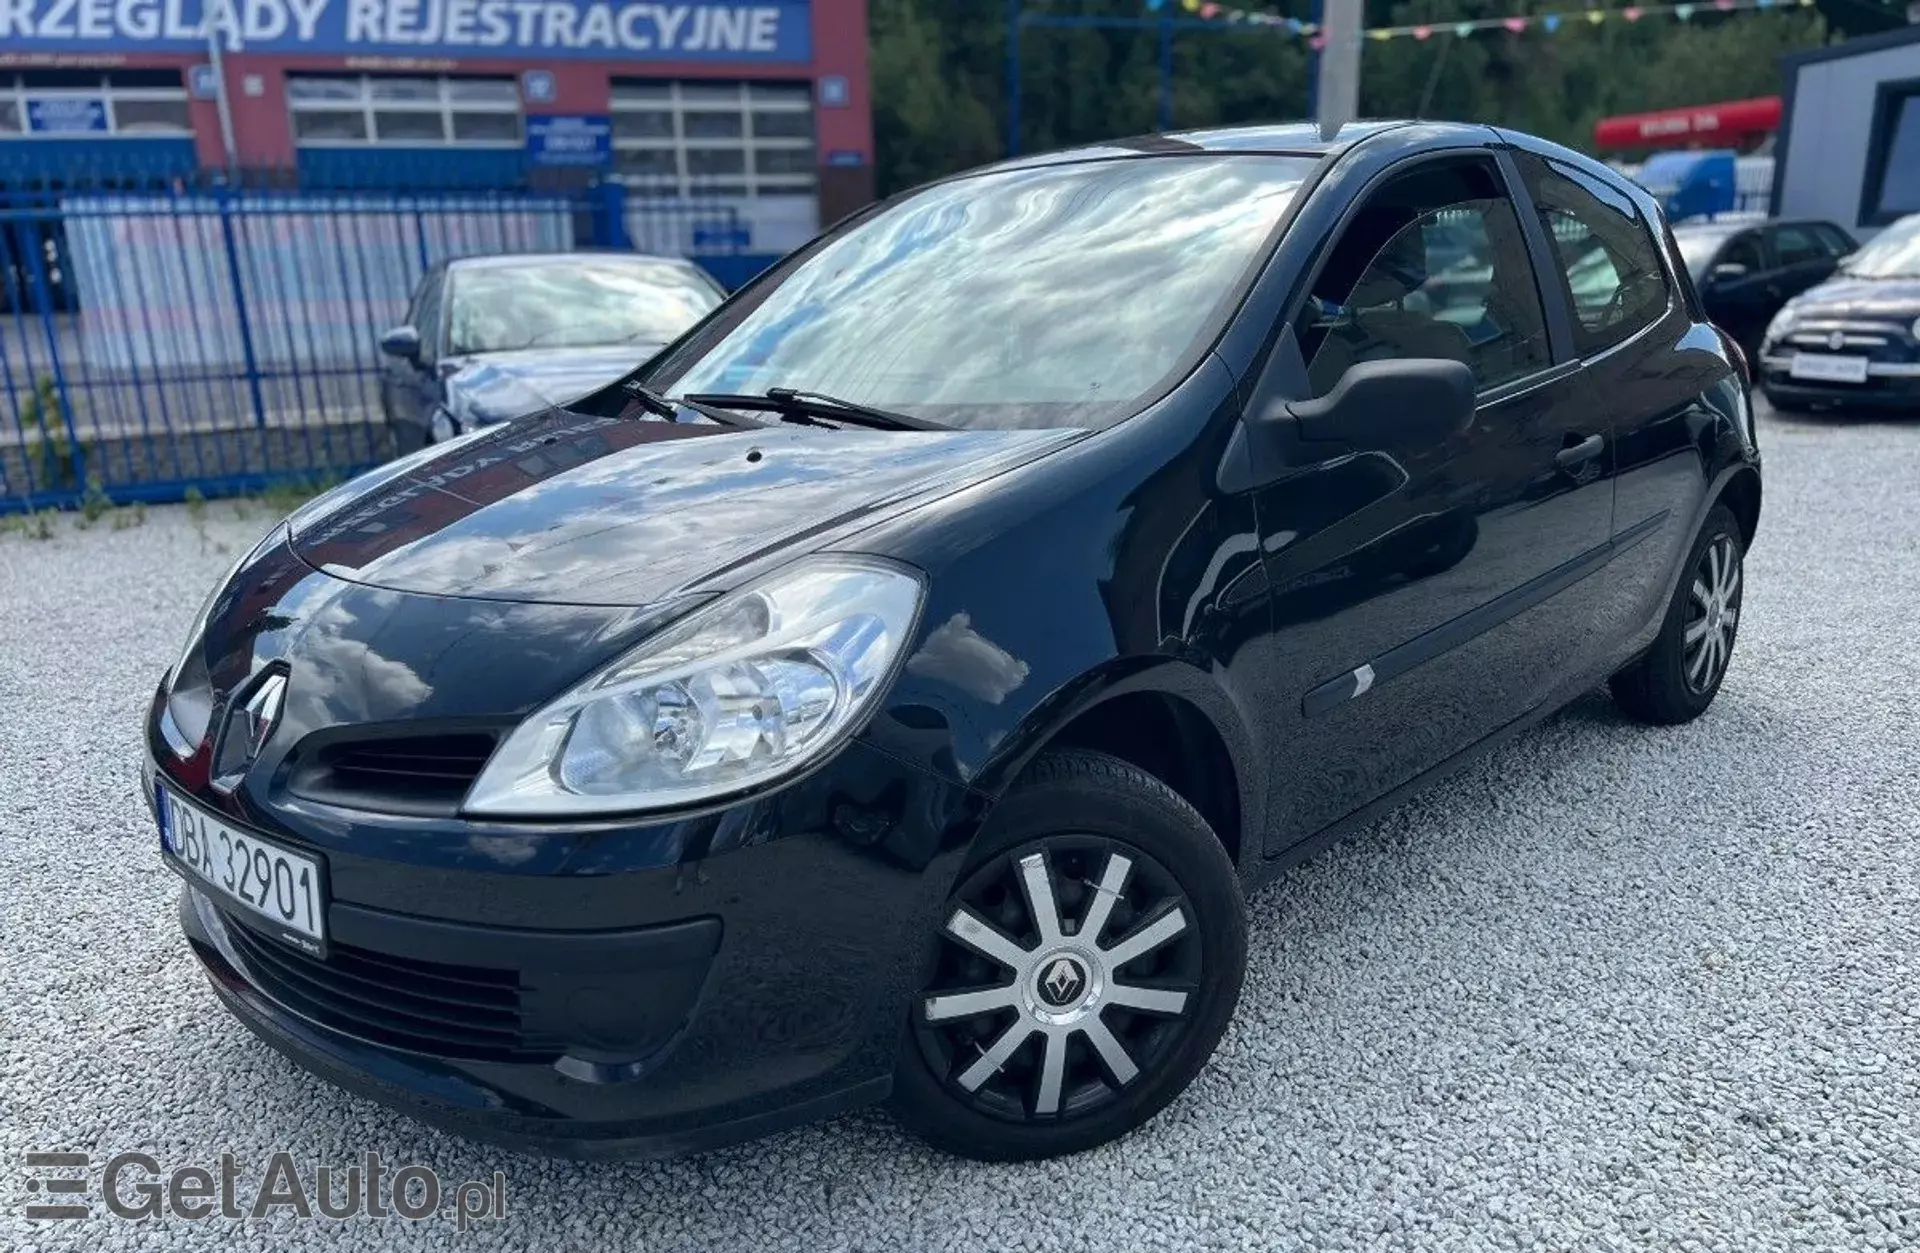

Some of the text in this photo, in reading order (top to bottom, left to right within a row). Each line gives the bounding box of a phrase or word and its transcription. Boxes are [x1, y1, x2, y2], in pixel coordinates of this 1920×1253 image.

[345, 0, 780, 51] REJESTRACYJNE
[170, 797, 314, 932] DBA 32901
